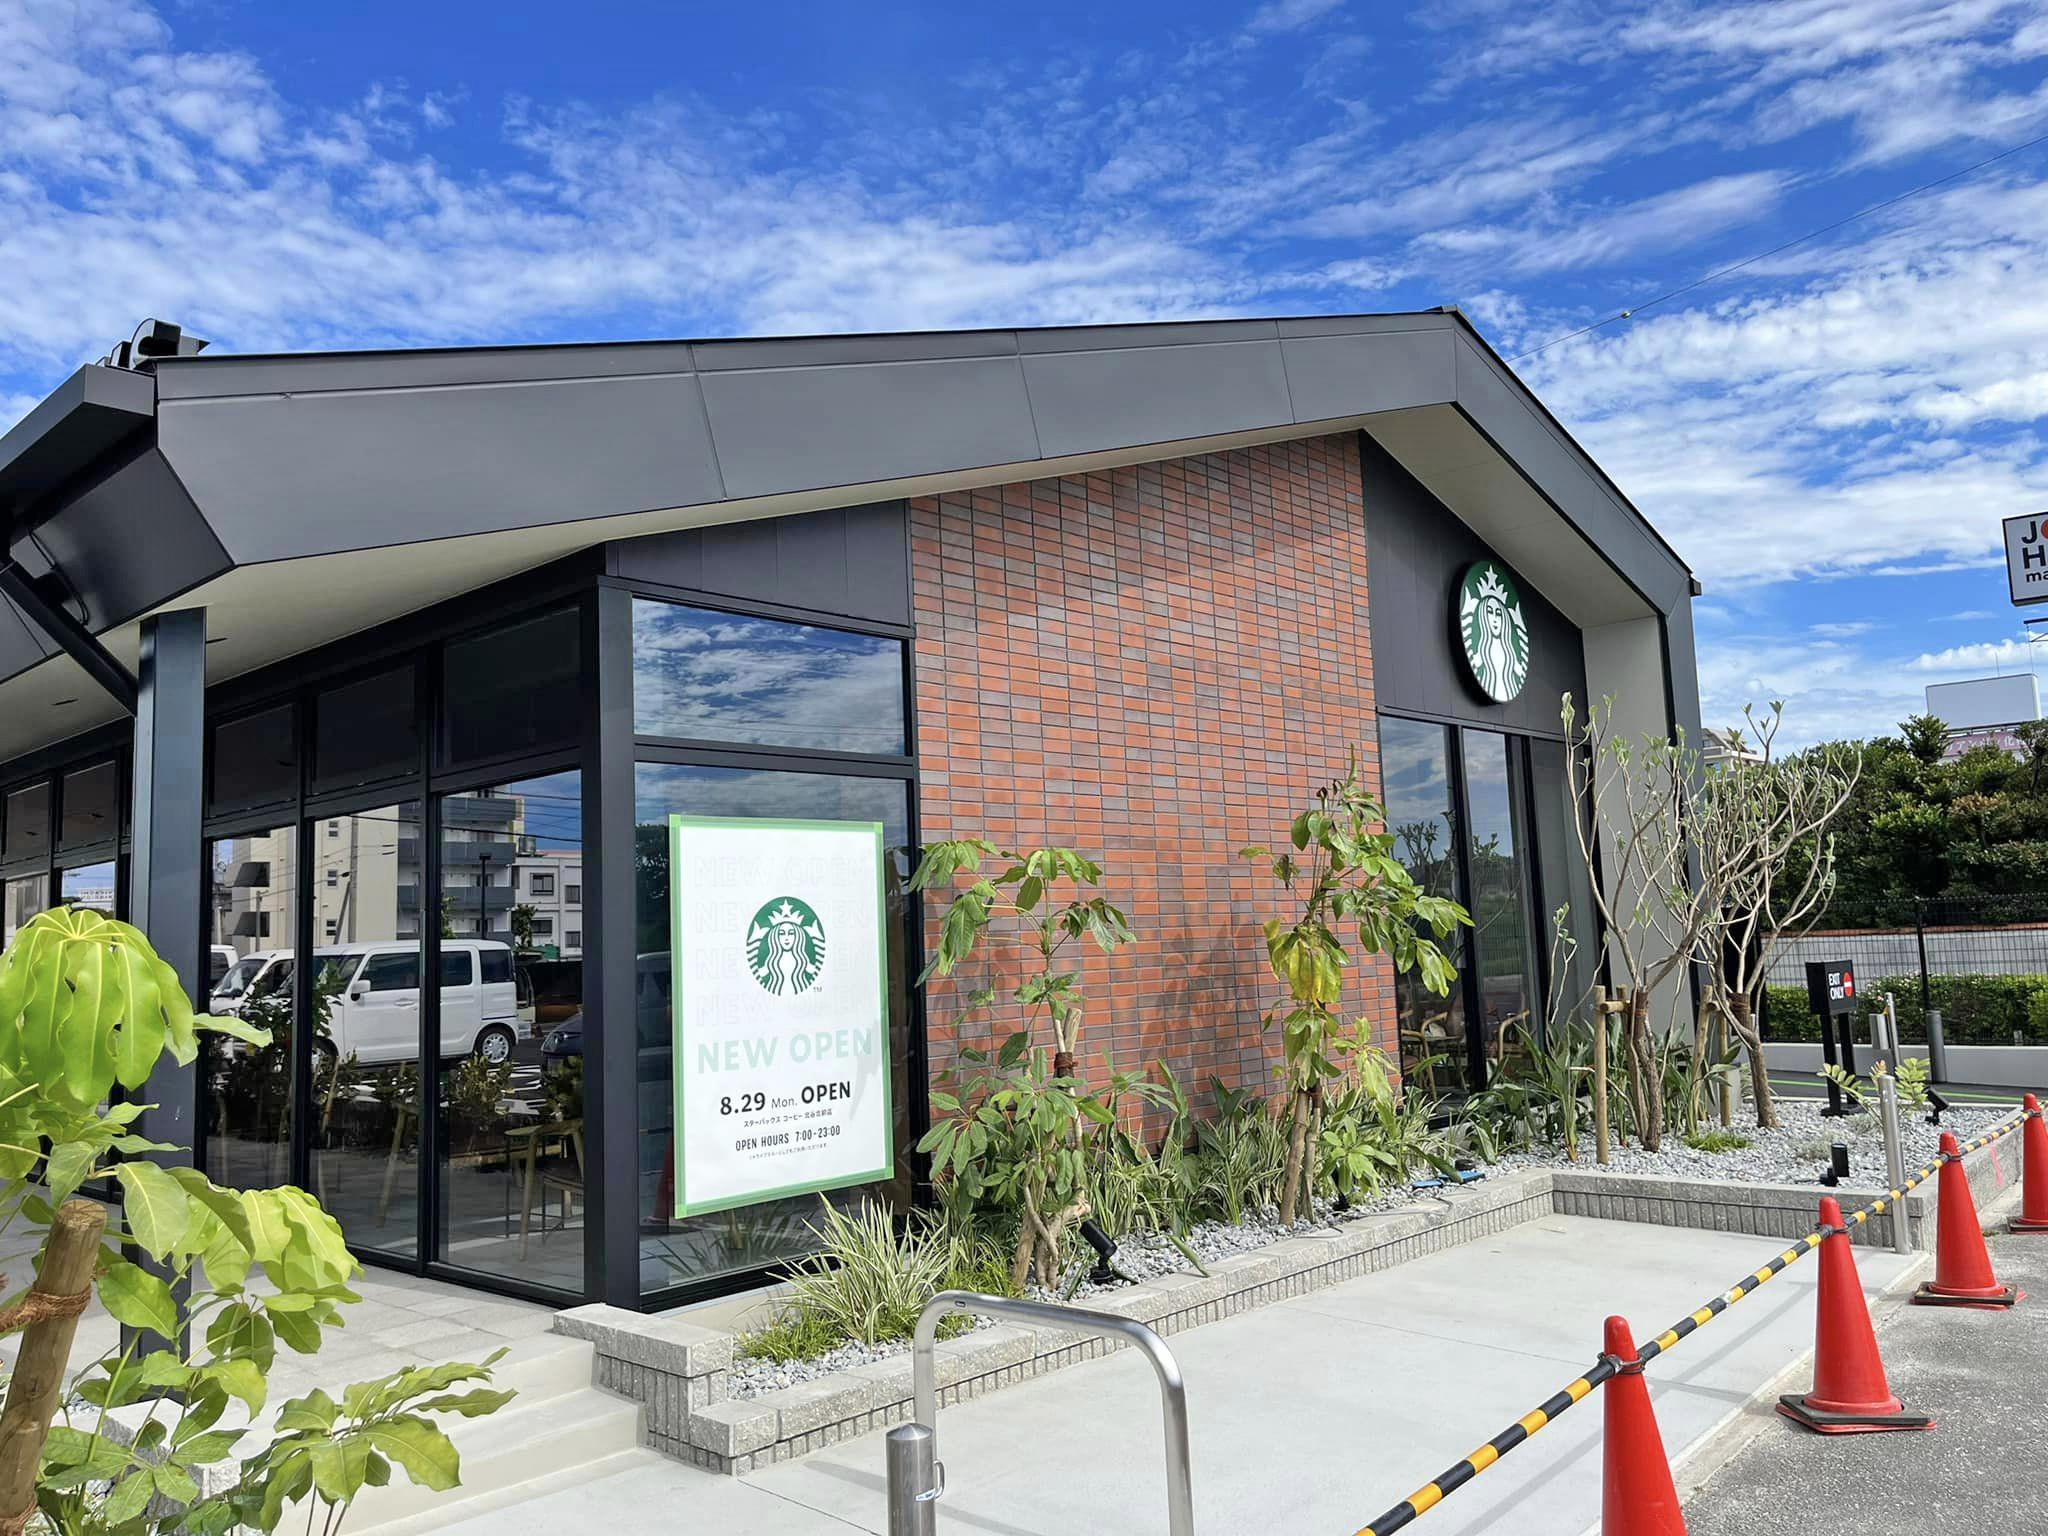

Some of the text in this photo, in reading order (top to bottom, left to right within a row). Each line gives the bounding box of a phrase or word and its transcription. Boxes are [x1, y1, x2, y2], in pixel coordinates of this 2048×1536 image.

[1828, 972, 1840, 986] EXIT
[1829, 986, 1844, 1000] ONLY
[698, 1028, 872, 1074] NEW OPEN
[720, 1081, 851, 1116] 8.29 Mon. OPEN
[735, 1137, 757, 1152] OPEN
[761, 1132, 789, 1147] HOURS
